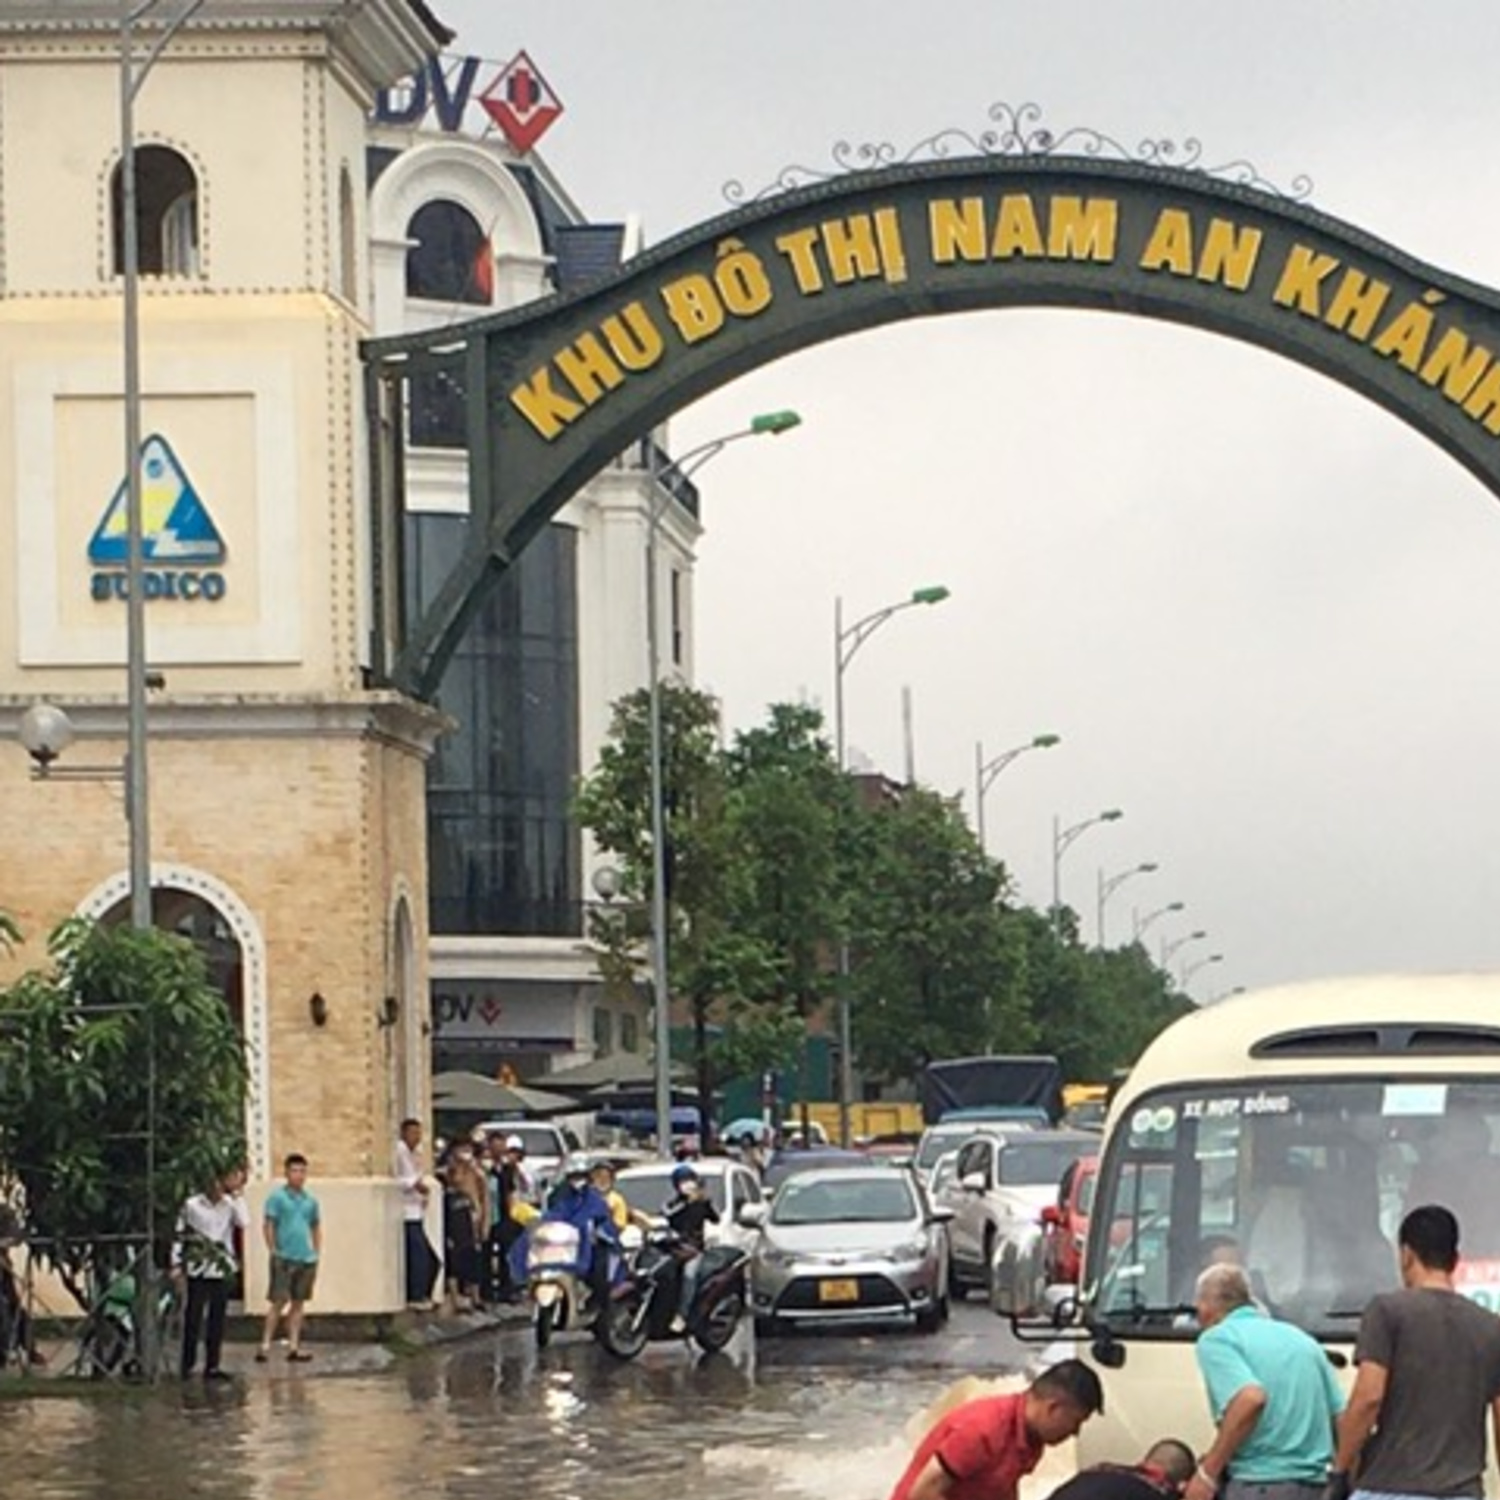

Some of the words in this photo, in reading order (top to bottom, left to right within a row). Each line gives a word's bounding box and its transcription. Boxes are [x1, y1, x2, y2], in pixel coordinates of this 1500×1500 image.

[510, 301, 663, 441] KHU
[660, 237, 773, 345] ĐÔ
[776, 206, 908, 295] THỊ
[928, 193, 1119, 264] NAM
[1139, 207, 1264, 292] AN
